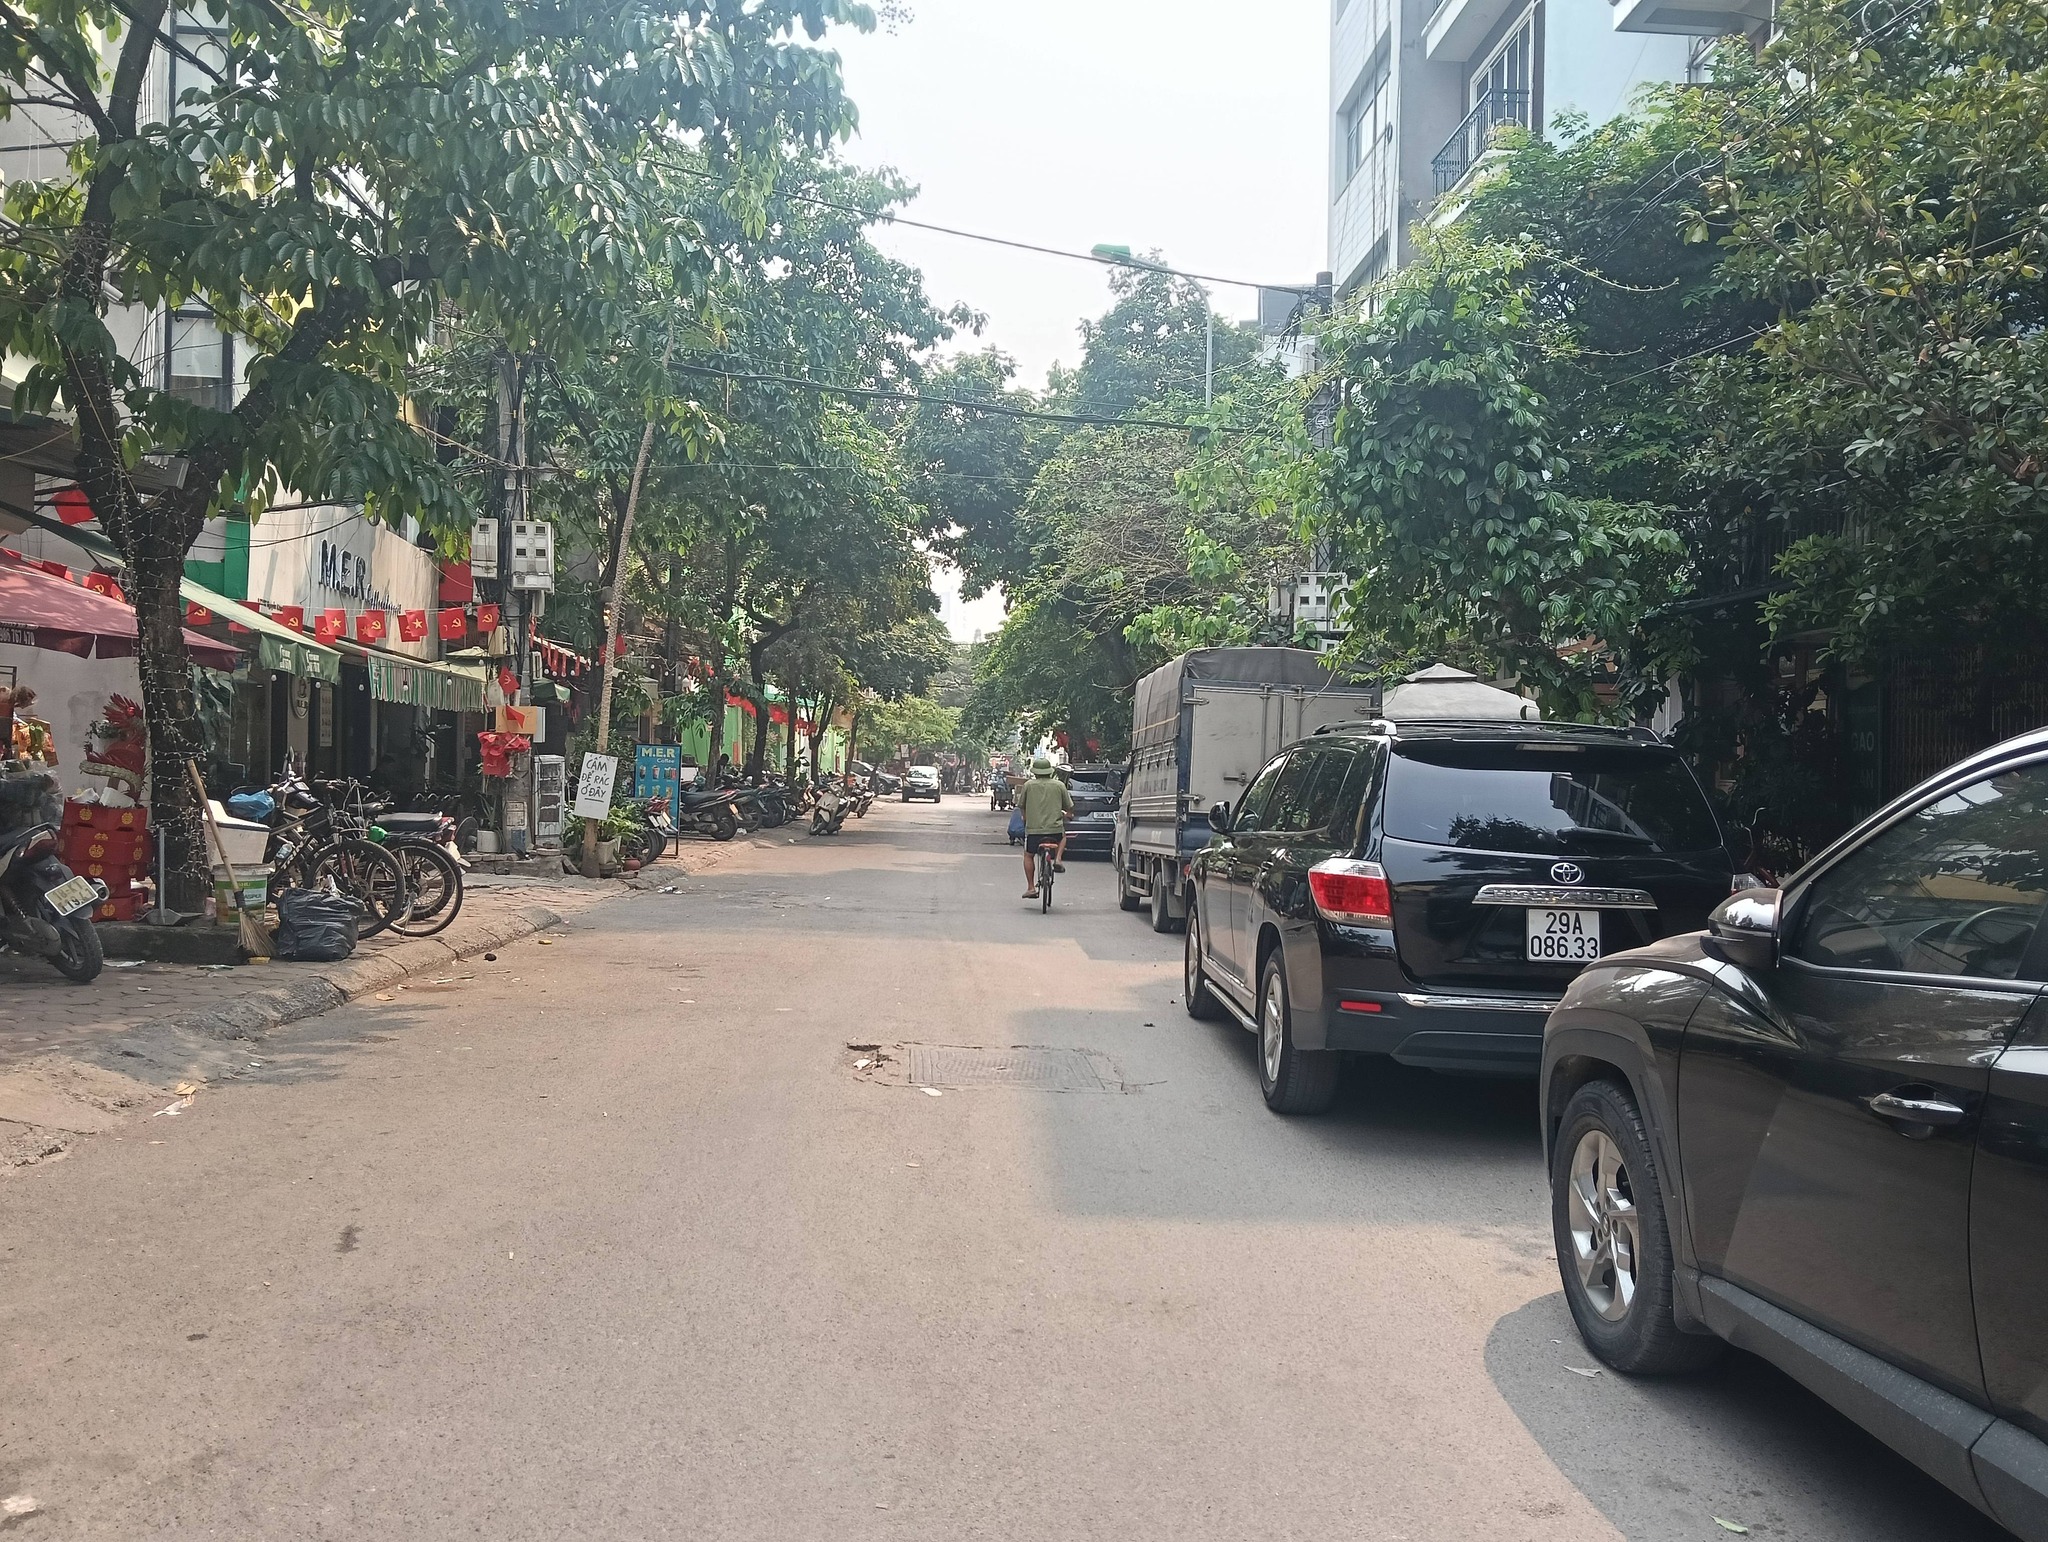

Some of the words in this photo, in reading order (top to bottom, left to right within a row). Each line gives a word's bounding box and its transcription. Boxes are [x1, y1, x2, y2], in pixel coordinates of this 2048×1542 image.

[641, 747, 675, 758] M.E.R
[586, 756, 608, 772] CẤM
[594, 773, 610, 786] RÁC
[589, 787, 606, 798] ĐÂY
[1545, 912, 1583, 935] 29A
[1530, 935, 1598, 959] 086.33
